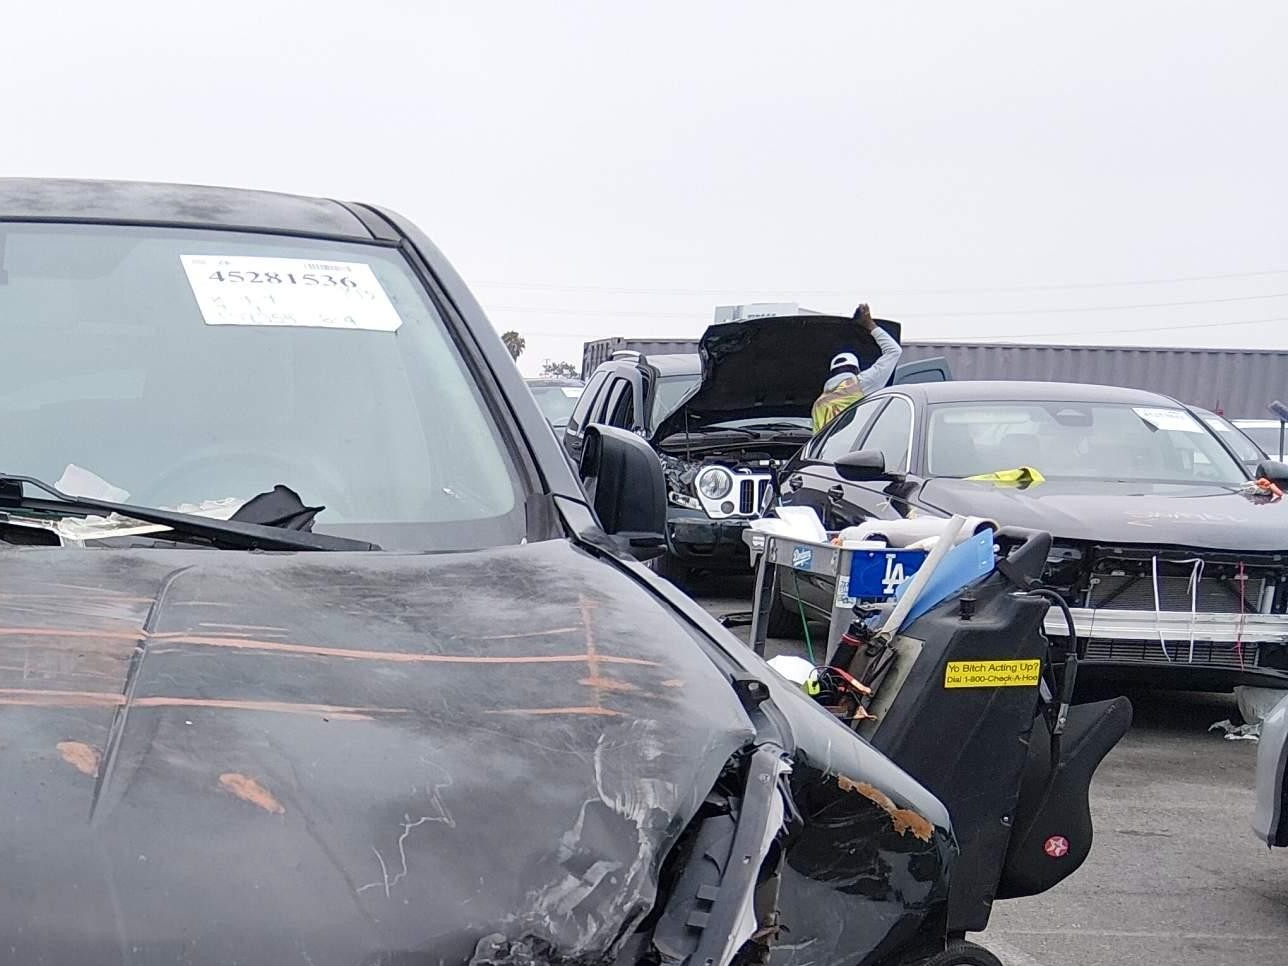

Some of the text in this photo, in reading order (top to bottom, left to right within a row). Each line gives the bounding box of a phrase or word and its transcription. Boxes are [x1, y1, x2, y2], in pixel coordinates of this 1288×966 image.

[208, 270, 357, 289] 45281536
[882, 553, 909, 595] LA
[948, 662, 1039, 674] Yo Bitch Acting Up?
[947, 675, 962, 684] Dial
